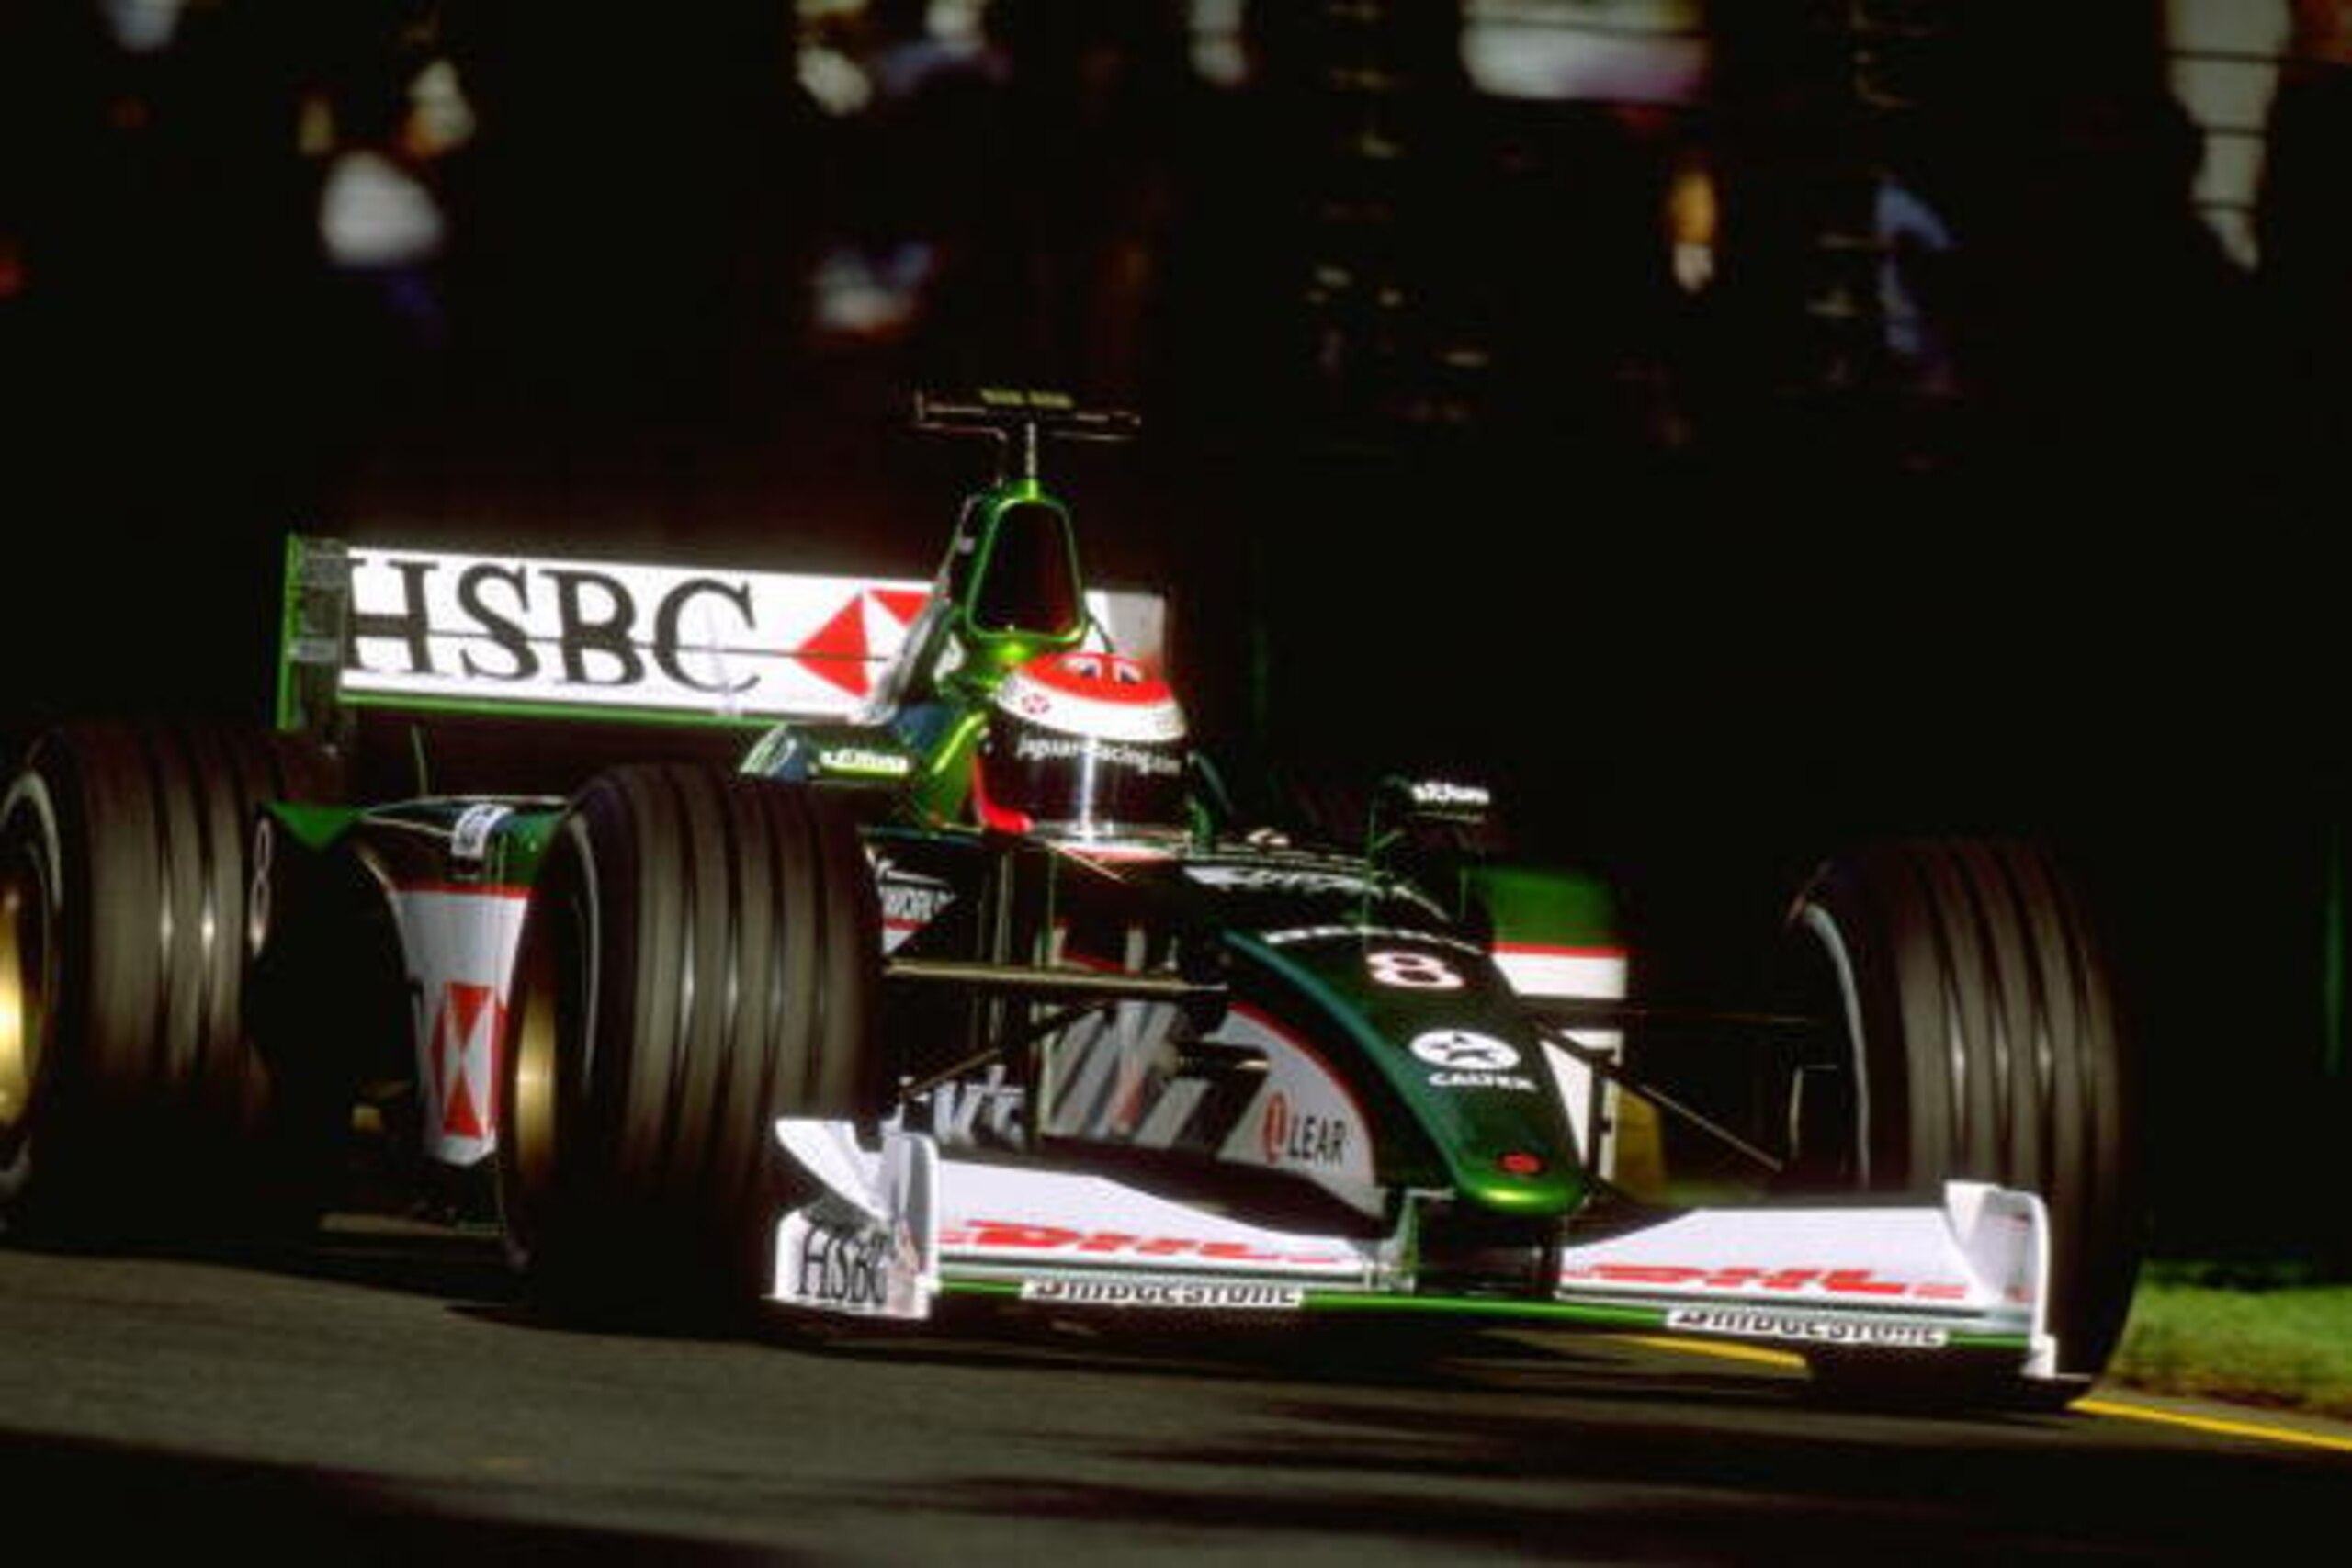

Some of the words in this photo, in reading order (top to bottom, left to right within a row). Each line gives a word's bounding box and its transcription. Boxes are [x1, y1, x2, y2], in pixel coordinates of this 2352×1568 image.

[341, 557, 762, 694] HSBC
[1366, 952, 1464, 988] 8
[1288, 1113, 1347, 1167] LEAR
[1592, 1264, 1906, 1295] DHL
